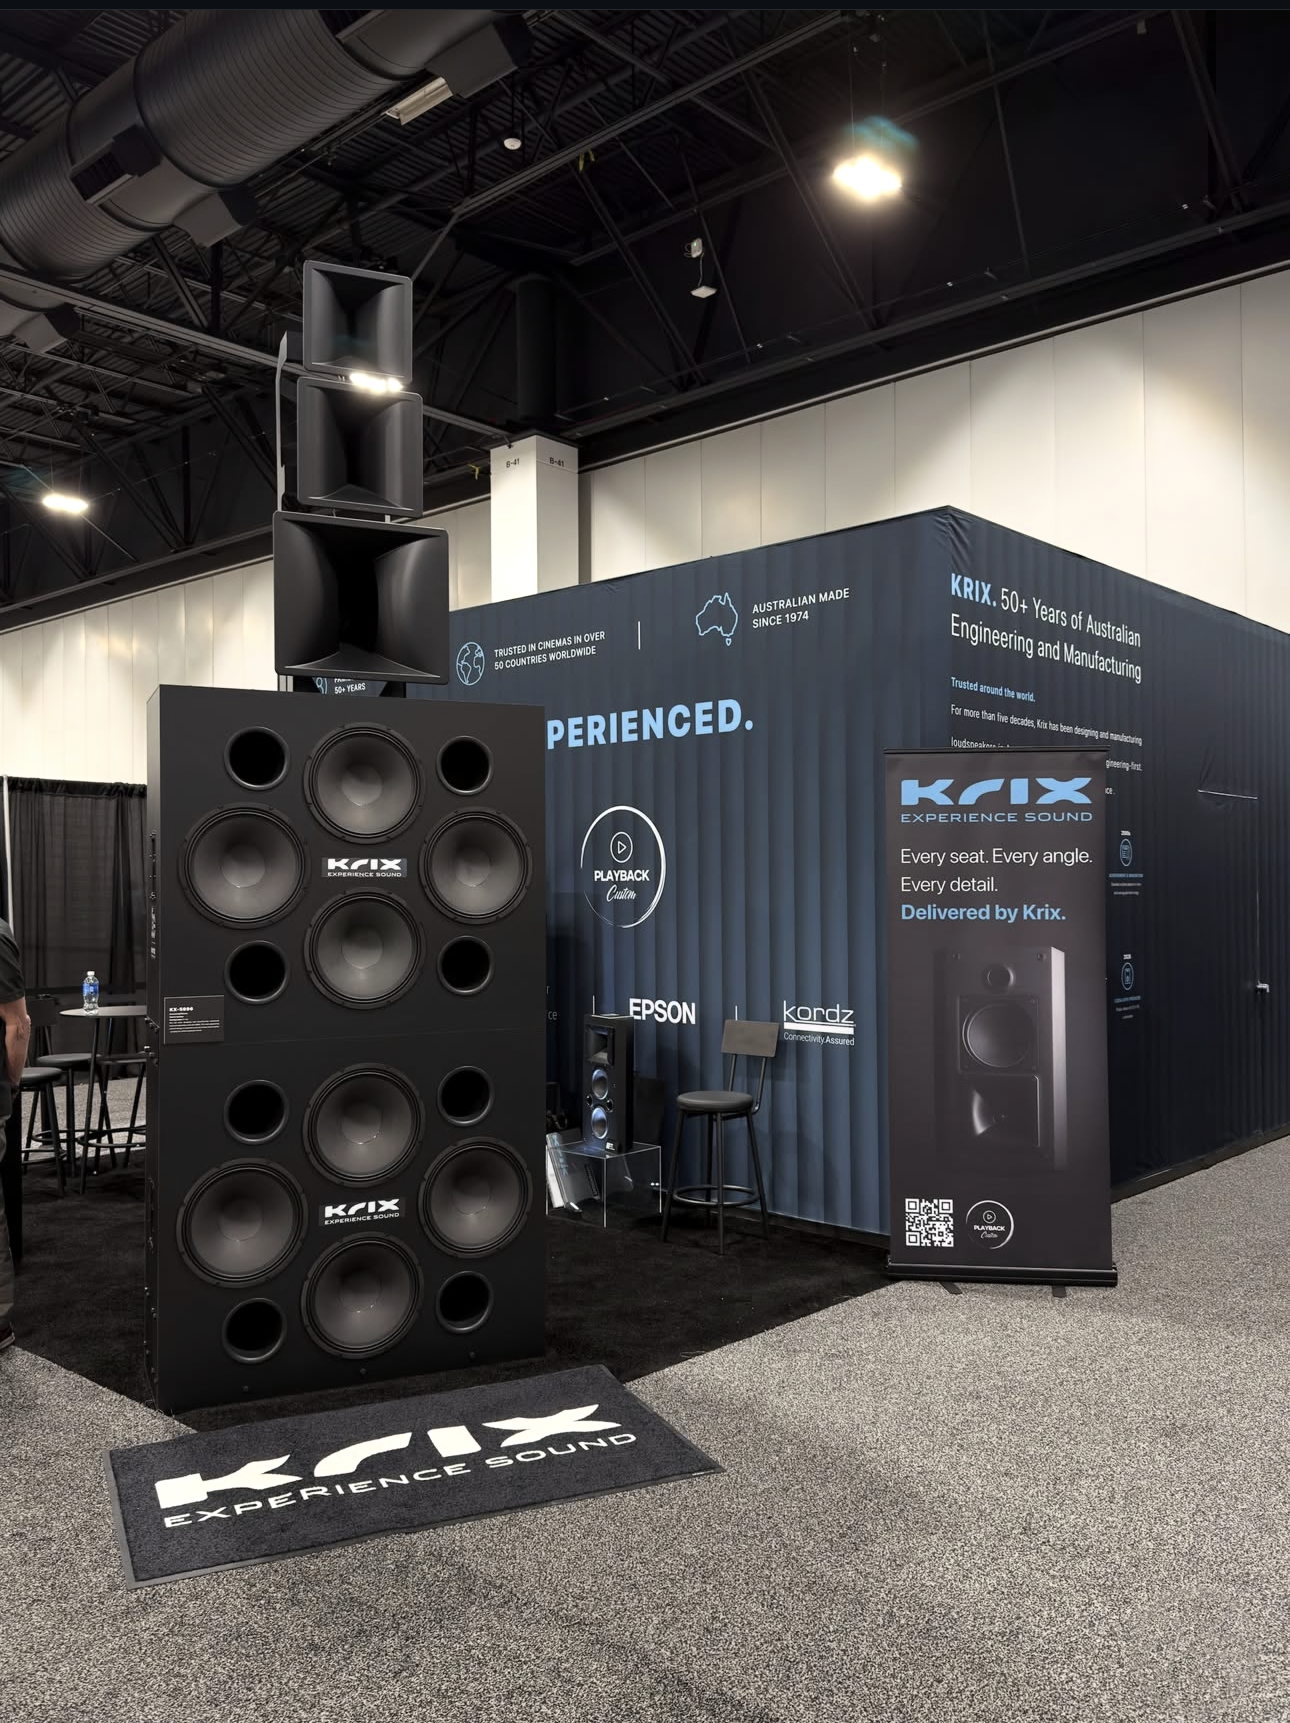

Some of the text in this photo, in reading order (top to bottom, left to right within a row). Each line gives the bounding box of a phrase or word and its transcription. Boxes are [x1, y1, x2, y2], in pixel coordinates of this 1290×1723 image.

[549, 457, 564, 467] B-41
[752, 588, 850, 614] AUSTRALIAN MADE
[951, 573, 1141, 648] KRIX. 50+ Years of Australian
[752, 610, 809, 629] SINCE 1974
[494, 631, 606, 658] TRUSTED IN CINEMAS IN OVER
[951, 613, 1142, 684] Engineering and Manufacturing
[494, 646, 596, 670] 50 COUNTRIES WORLDWIDE
[334, 682, 366, 694] 50+ YEARS
[951, 676, 1036, 702] Trusted around the world.
[547, 698, 754, 750] PERIENCED.
[951, 704, 1142, 746] For more than five decades, Krix has been designing and manufacturing
[1105, 758, 1143, 772] gineering-first.
[901, 812, 1093, 823] EXPERIENCE SOUND
[901, 848, 1093, 866] Every seat. Every angle.
[594, 870, 650, 881] PLAYBACK
[901, 876, 999, 894] Every detail.
[607, 884, 636, 902] Custom
[901, 904, 1066, 923] Delivered by Krix.
[629, 998, 696, 1025] EPSON
[783, 1000, 855, 1024] kordz
[325, 1216, 371, 1225] EXPERIENCE
[163, 1433, 637, 1528] EXPERIENCE SOUND
